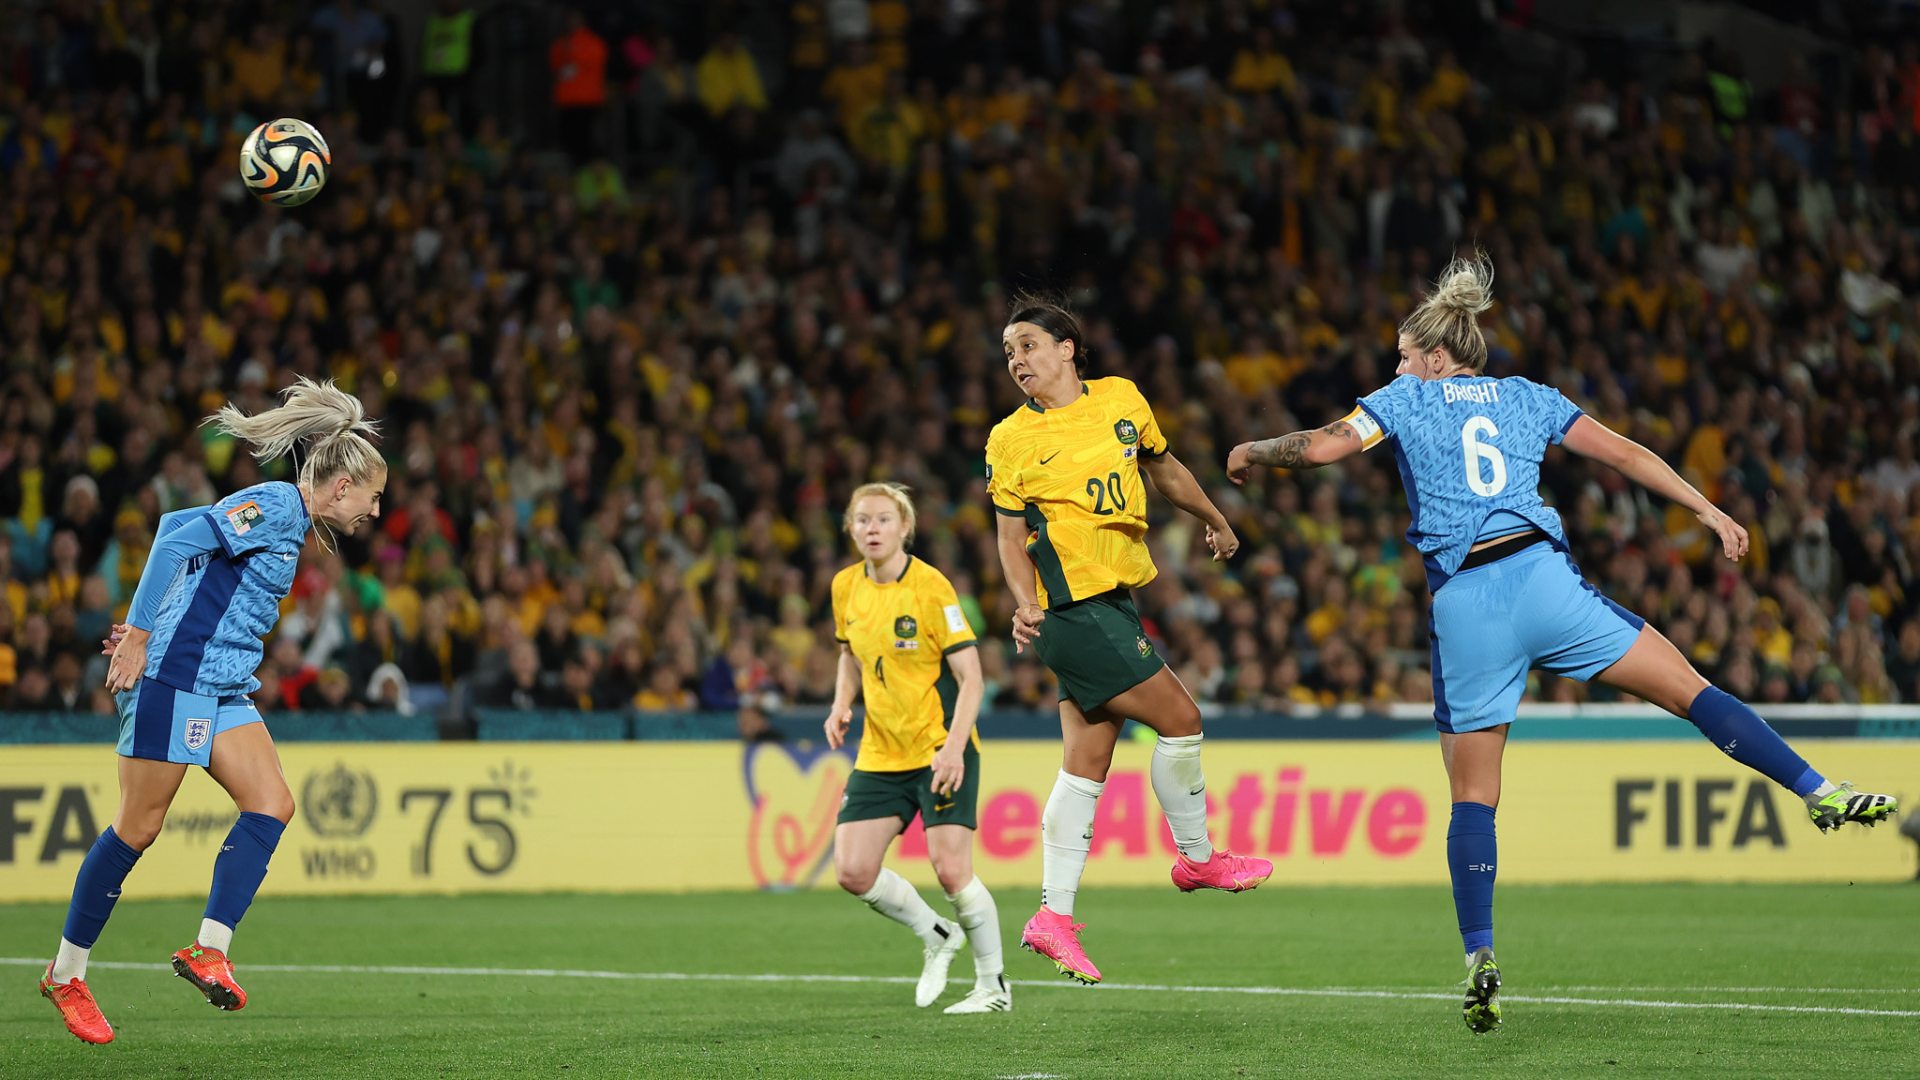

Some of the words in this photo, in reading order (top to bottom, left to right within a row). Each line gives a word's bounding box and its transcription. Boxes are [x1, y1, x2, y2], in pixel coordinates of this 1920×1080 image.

[1442, 382, 1500, 404] BRIGHT
[1461, 415, 1508, 497] 6
[1086, 472, 1126, 515] 20
[398, 787, 517, 875] 75
[1614, 778, 1787, 848] FIFA
[301, 847, 377, 878] WHO
